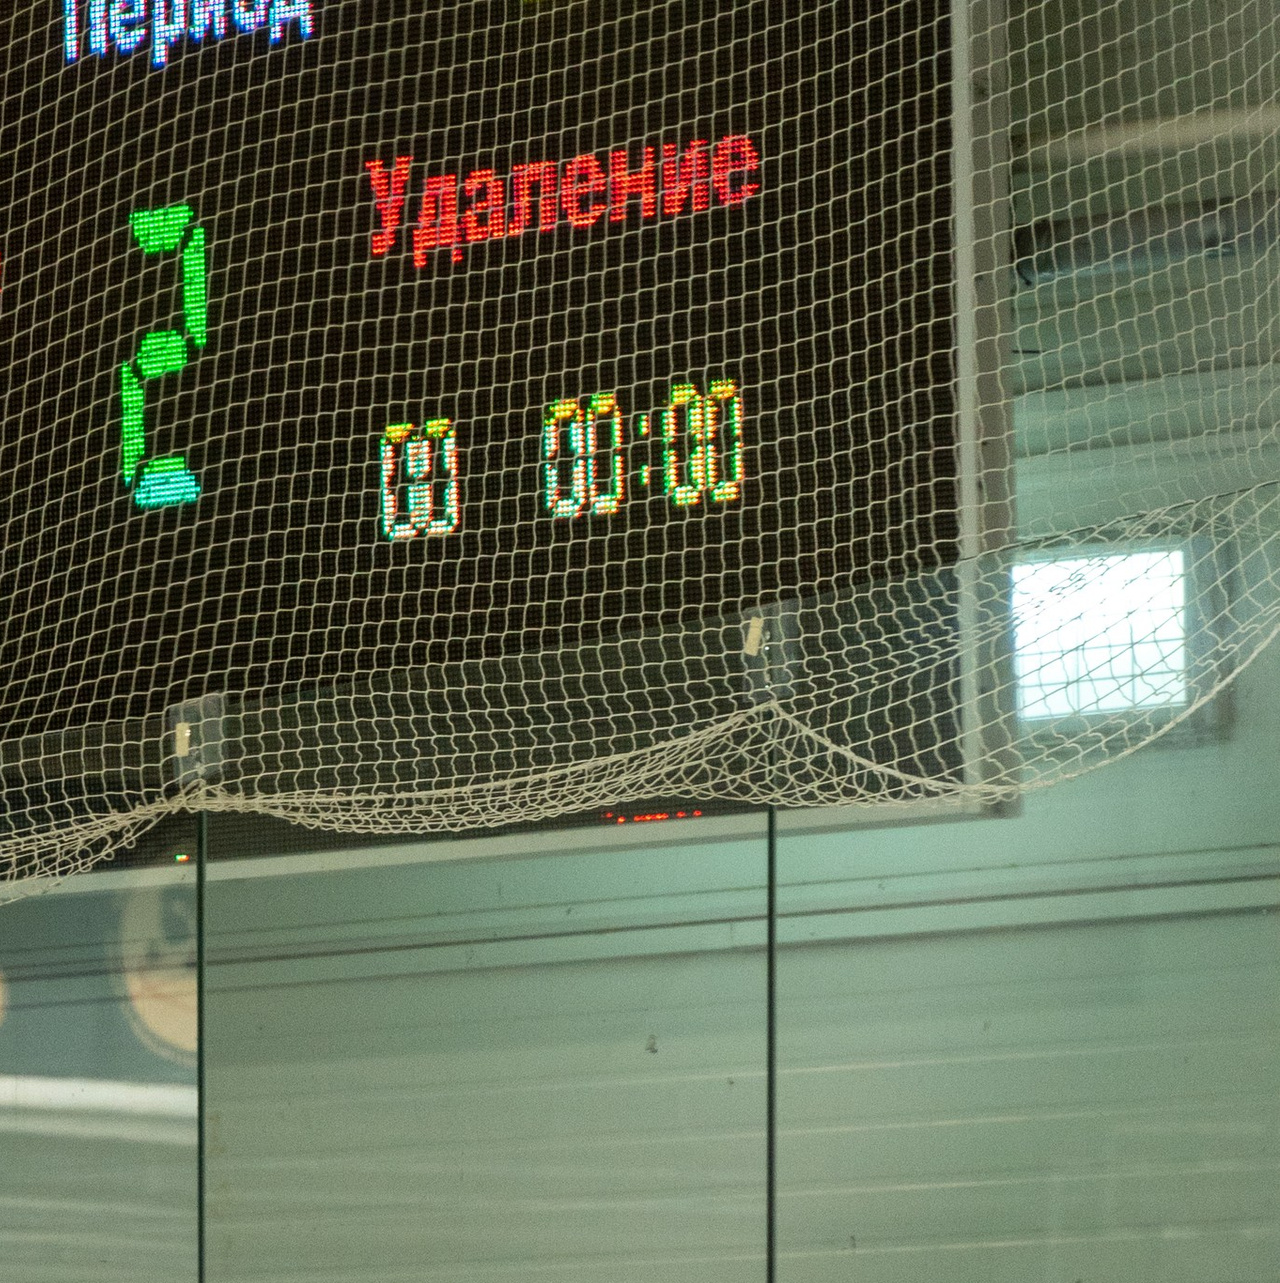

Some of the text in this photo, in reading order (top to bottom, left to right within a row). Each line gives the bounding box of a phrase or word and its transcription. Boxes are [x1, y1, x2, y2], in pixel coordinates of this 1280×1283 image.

[364, 133, 761, 268] Удаление
[121, 204, 207, 507] 2
[544, 378, 745, 519] 00:00
